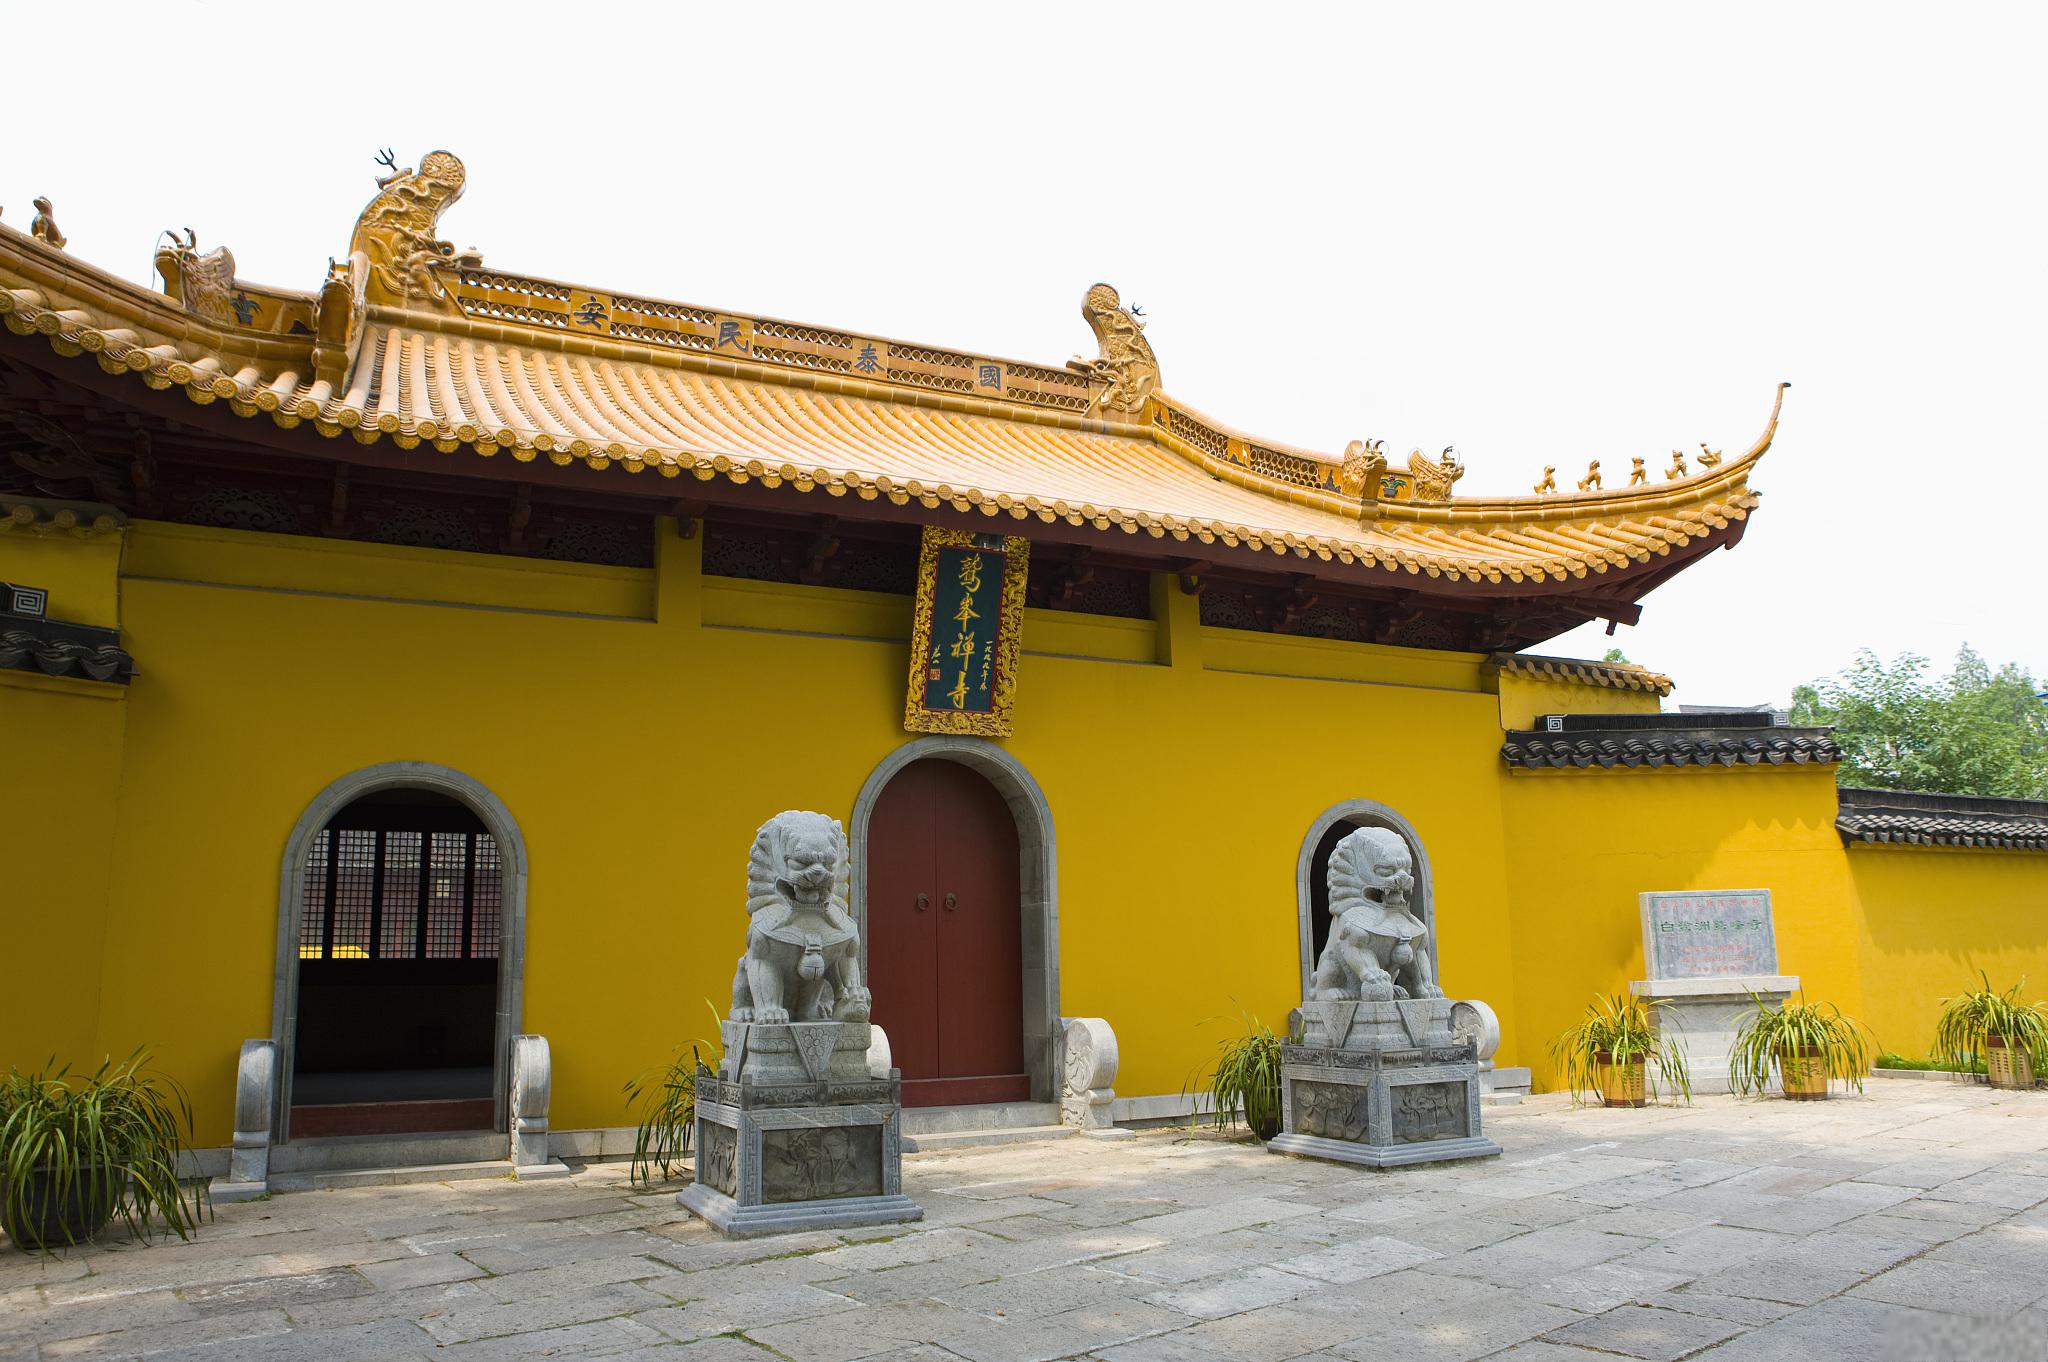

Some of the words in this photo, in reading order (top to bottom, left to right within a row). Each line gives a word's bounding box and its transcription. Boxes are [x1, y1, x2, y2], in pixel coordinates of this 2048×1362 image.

[573, 295, 609, 330] 安
[718, 320, 750, 353] 民
[854, 343, 886, 375] 泰
[978, 364, 1002, 392] 國
